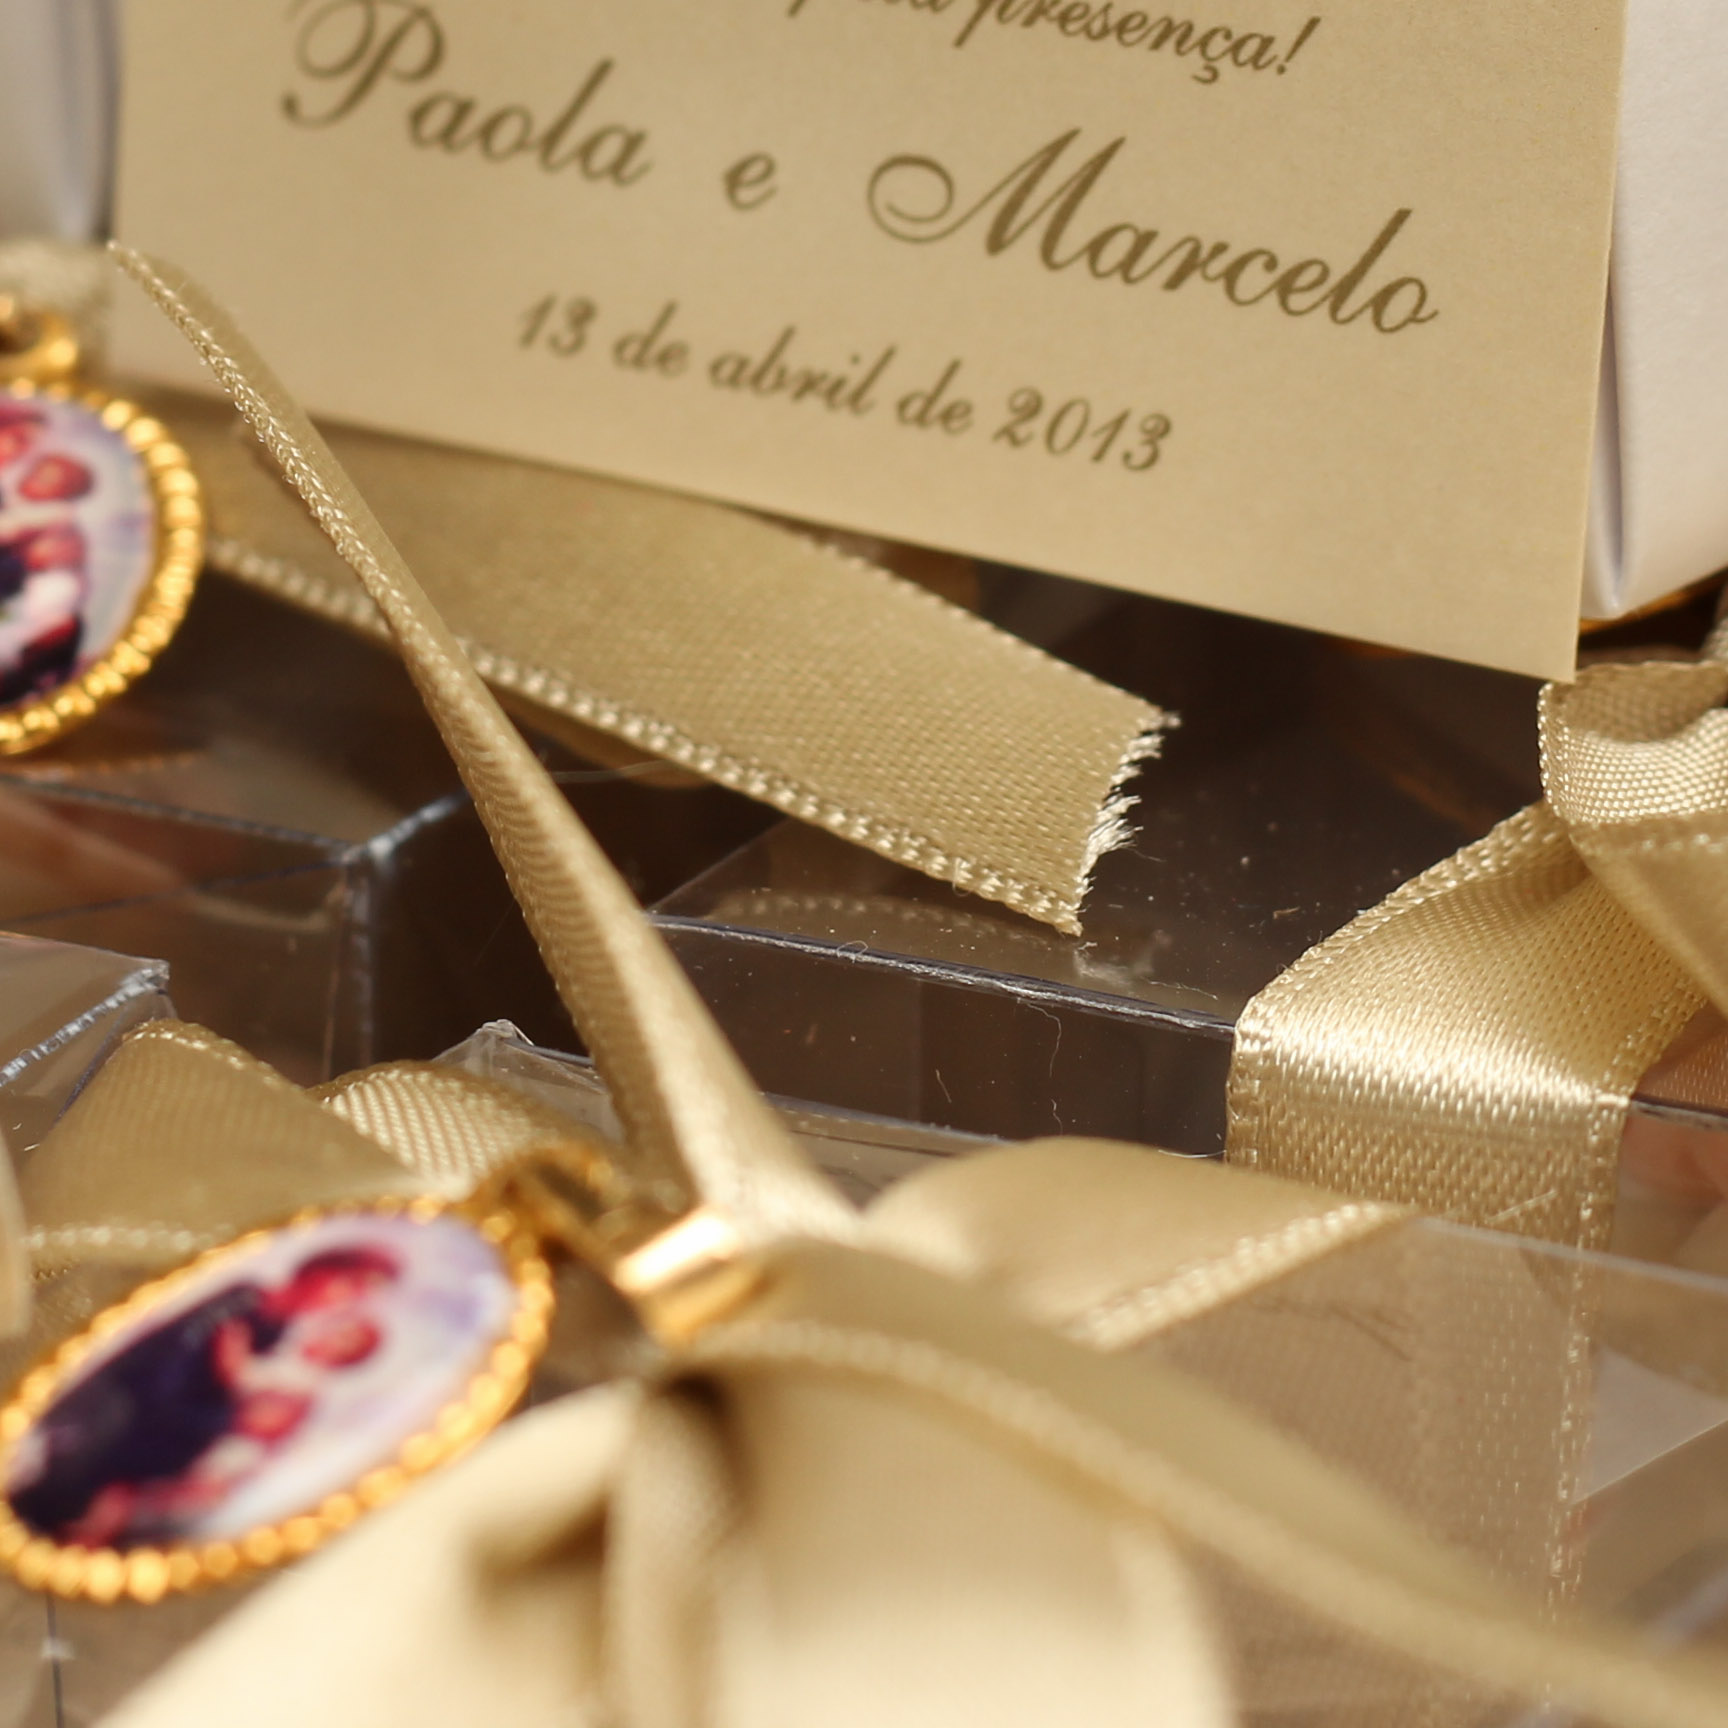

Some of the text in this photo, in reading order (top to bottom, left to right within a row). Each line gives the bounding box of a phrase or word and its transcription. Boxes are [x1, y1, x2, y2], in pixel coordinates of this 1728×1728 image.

[722, 144, 781, 211] e
[863, 125, 1438, 335] Marcelo
[515, 291, 1170, 474] 13 de abril de 2013
